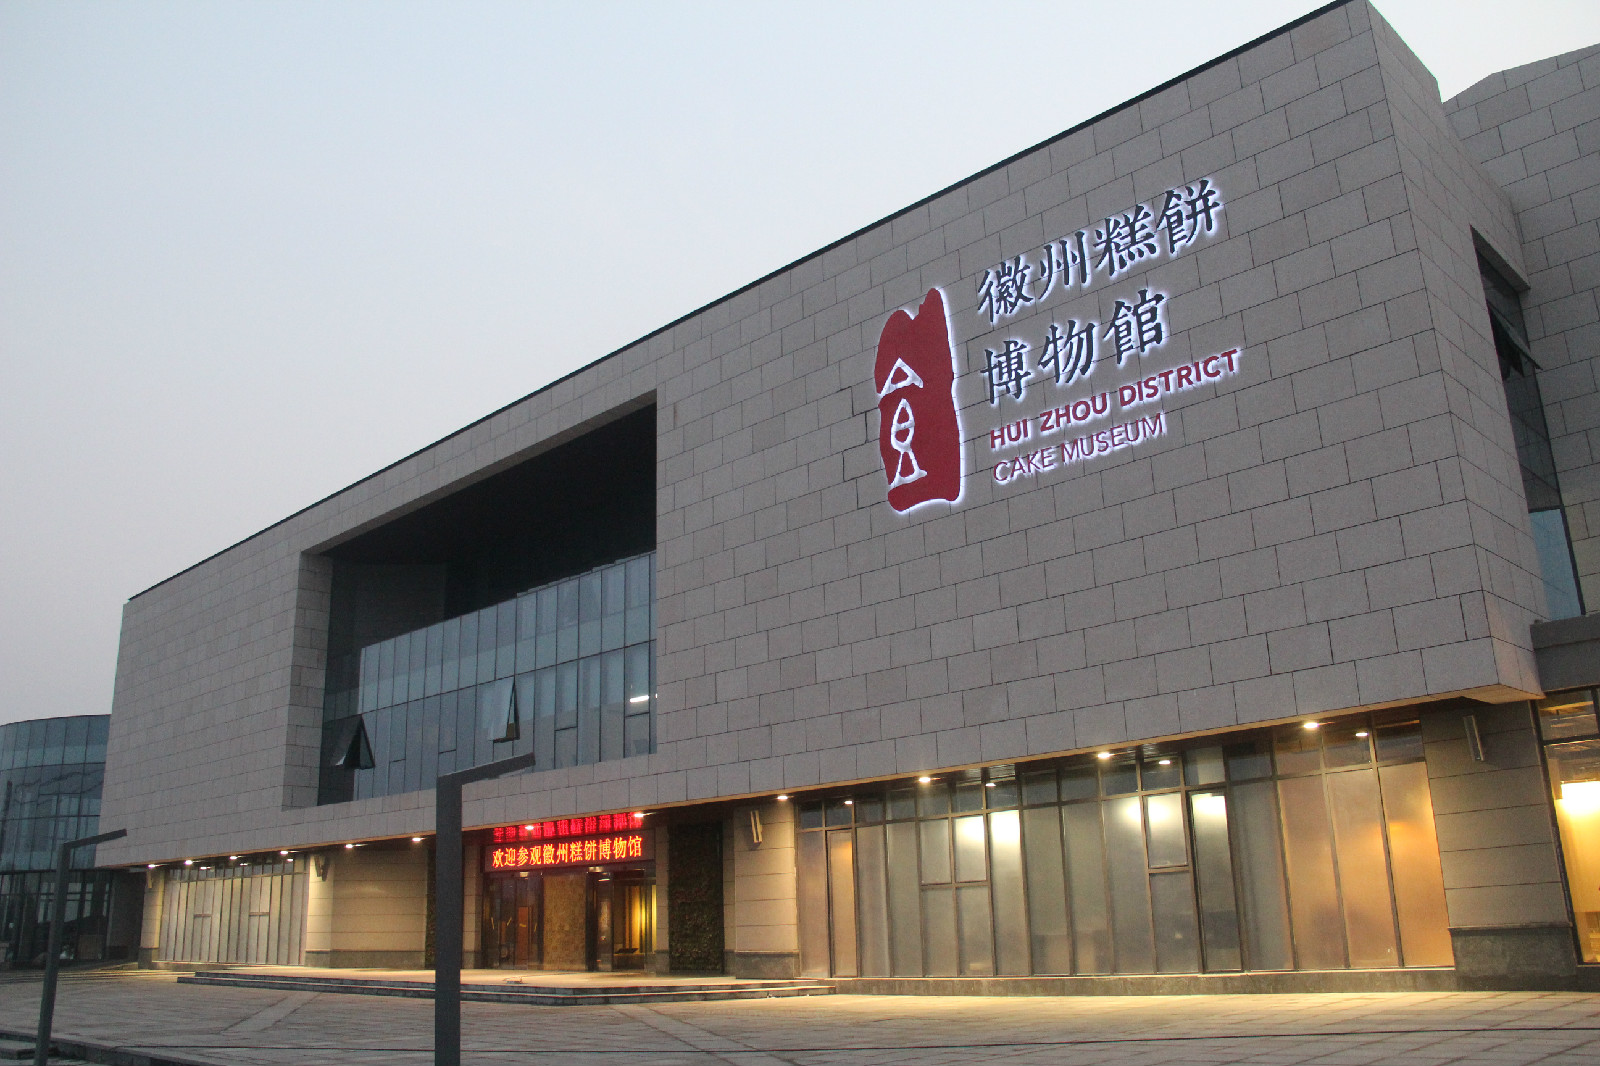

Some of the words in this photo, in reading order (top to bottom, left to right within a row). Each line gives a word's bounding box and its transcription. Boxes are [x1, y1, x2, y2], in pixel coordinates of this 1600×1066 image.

[980, 289, 1164, 404] 博物館
[990, 420, 1030, 449] HUI
[1039, 393, 1109, 433] ZHOU
[1119, 349, 1240, 407] DISTRICT
[993, 447, 1056, 483] CAKE
[1062, 414, 1168, 464] MUSEUM
[492, 835, 643, 868] 欢迎参观徽州糕饼博物馆
